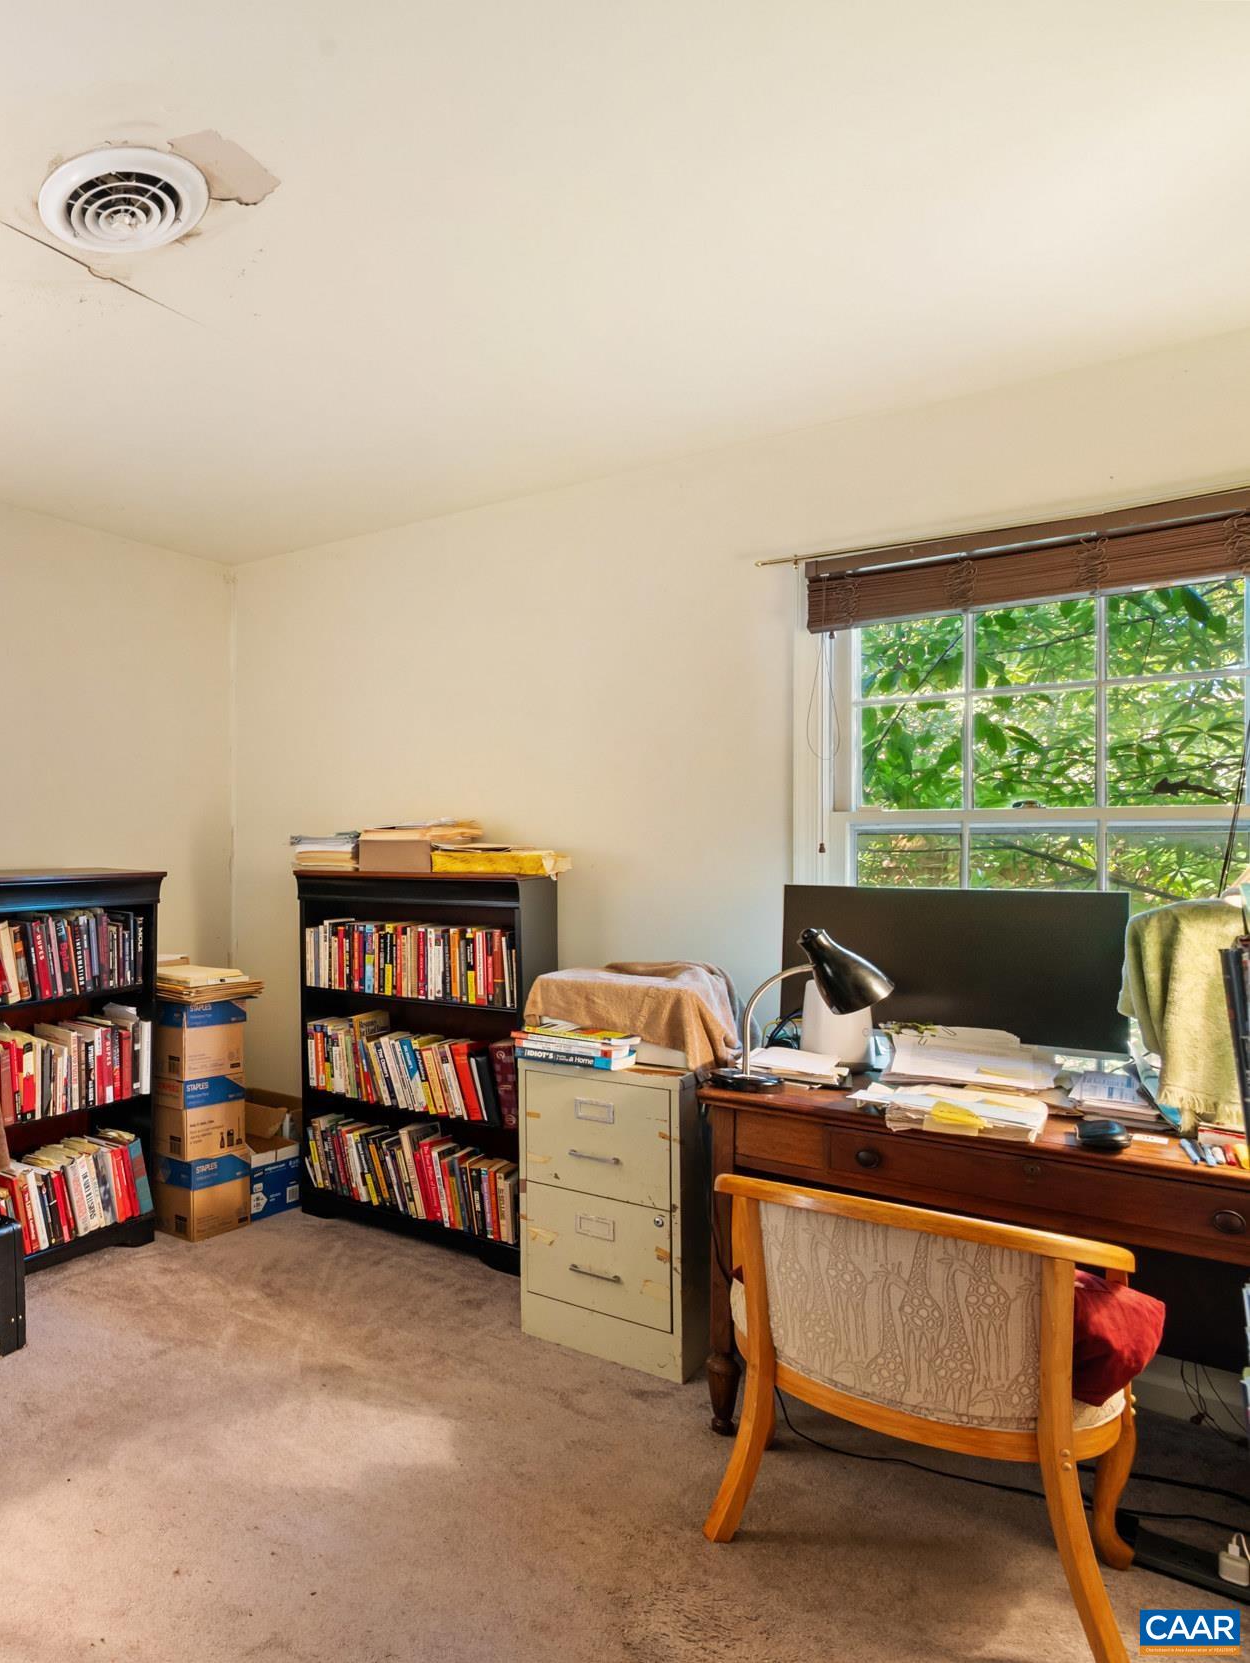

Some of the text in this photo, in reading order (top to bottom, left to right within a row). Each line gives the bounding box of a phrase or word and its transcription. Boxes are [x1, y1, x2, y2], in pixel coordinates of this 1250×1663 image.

[527, 1049, 554, 1060] IDIOT'S
[575, 1056, 594, 1065] Home
[186, 1082, 209, 1092] STAPLES
[195, 1162, 219, 1174] STAPLES
